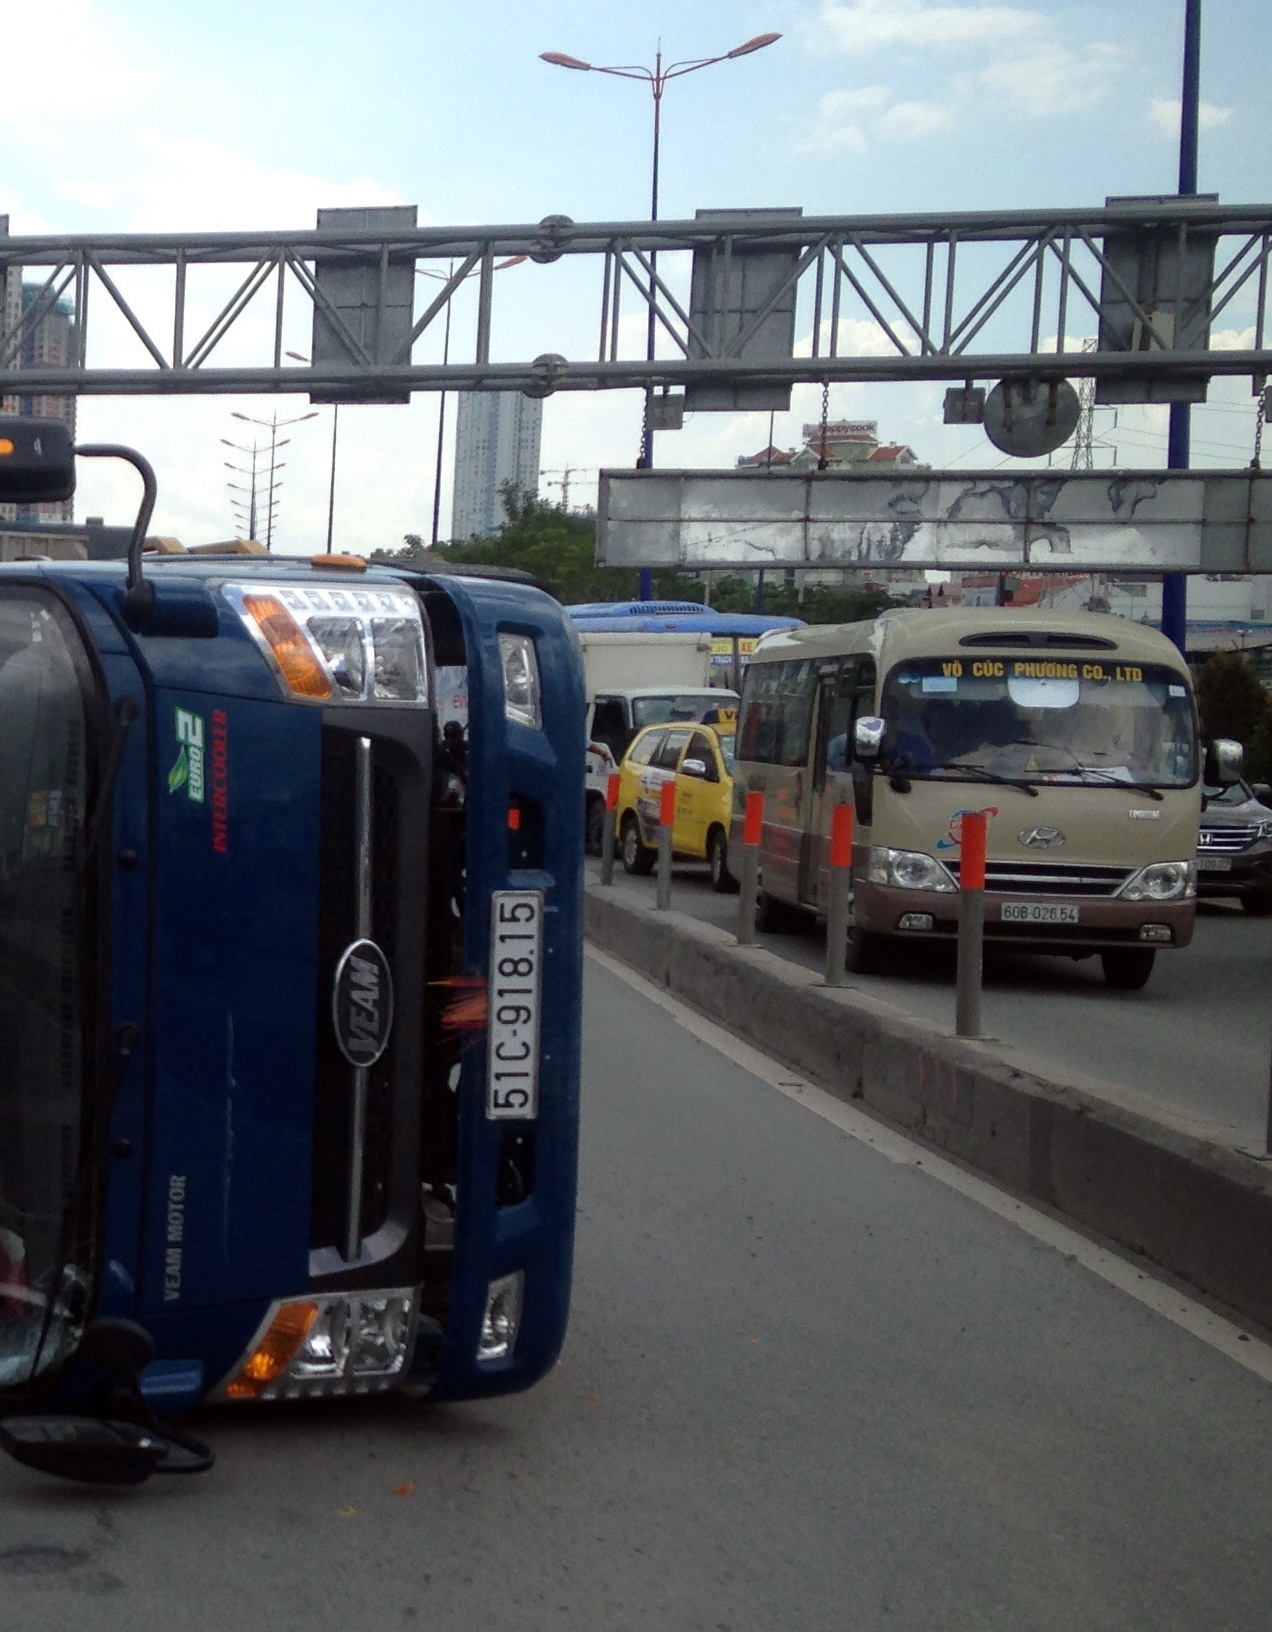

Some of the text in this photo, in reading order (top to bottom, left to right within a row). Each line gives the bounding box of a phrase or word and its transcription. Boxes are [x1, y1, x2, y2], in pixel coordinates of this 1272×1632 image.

[942, 659, 963, 678] VÔ
[972, 659, 1004, 677] CÚC
[1014, 660, 1078, 679] PHƯƠNG
[1116, 666, 1143, 682] LTD
[189, 746, 204, 801] EURO
[213, 709, 228, 854] INTERCOOLER
[1003, 906, 1076, 921] 60B-026.54
[348, 953, 380, 1054] VEAM
[493, 901, 535, 1110] 51C-918.15
[164, 1174, 186, 1302] VEAM MOTOR
